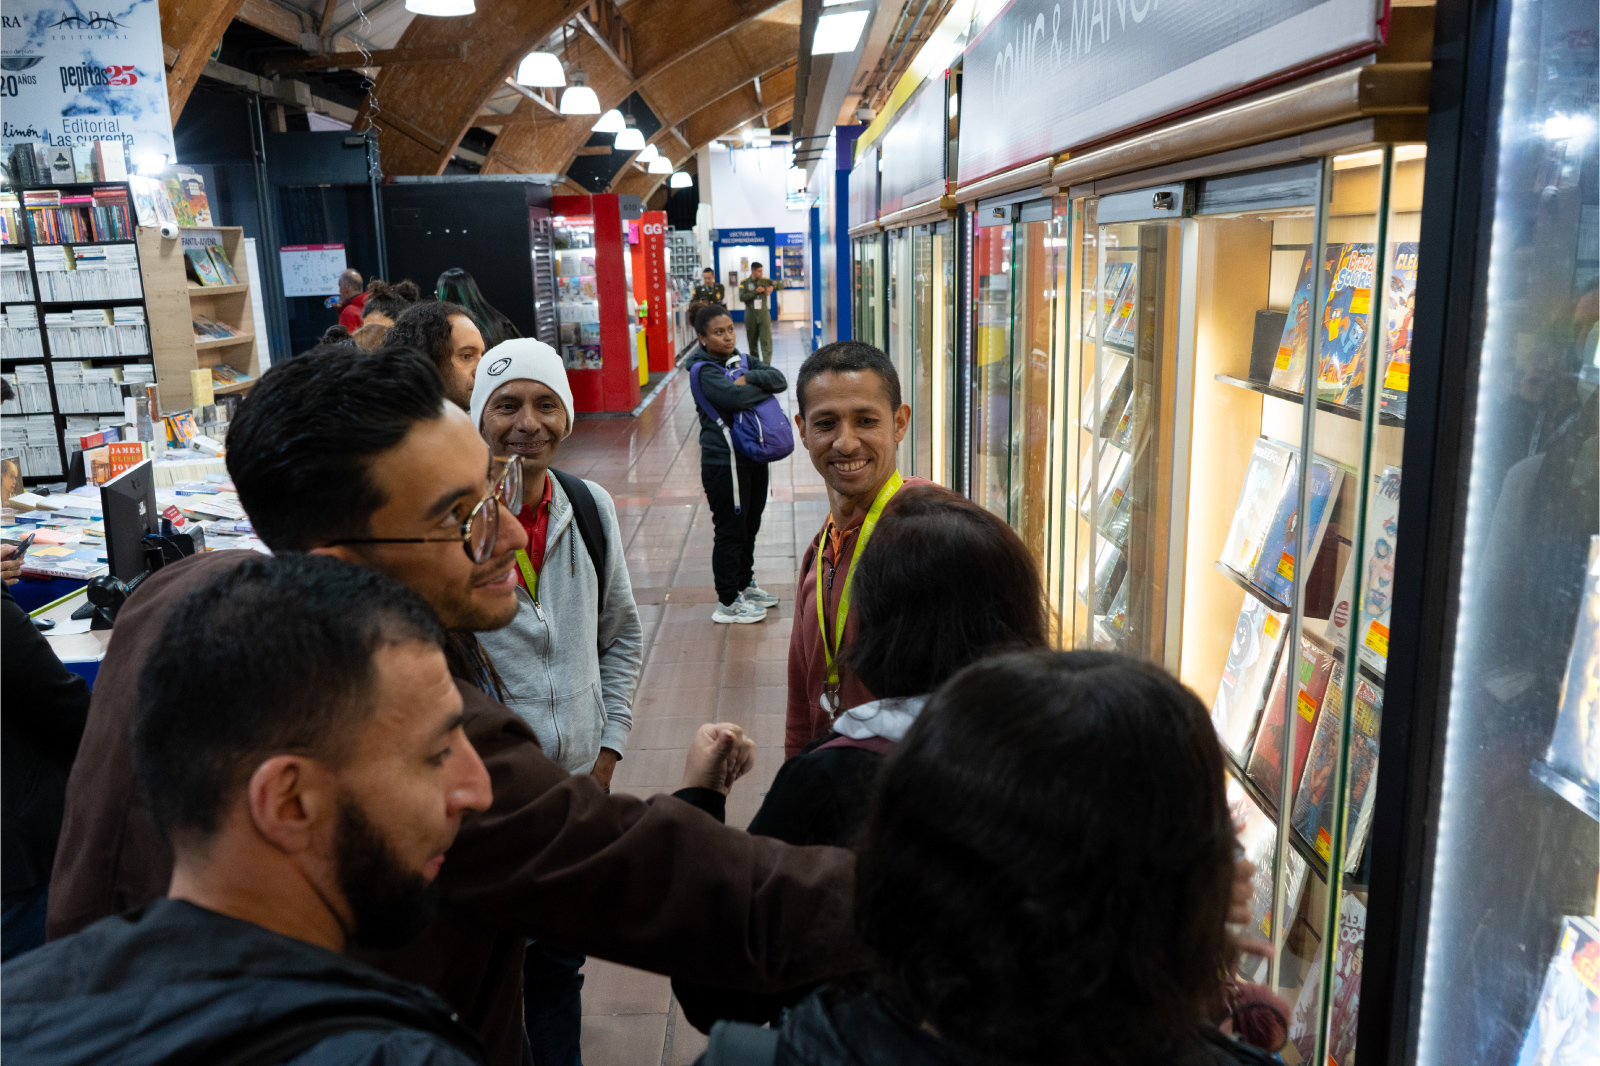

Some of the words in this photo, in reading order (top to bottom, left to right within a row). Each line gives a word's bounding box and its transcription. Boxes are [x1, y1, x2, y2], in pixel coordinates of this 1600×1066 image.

[59, 11, 119, 30] ALBA
[18, 74, 37, 85] AÑOS
[59, 62, 108, 94] pepitas
[106, 65, 138, 87] 25
[3, 121, 42, 139] limón
[62, 119, 121, 134] Editorial
[49, 132, 72, 147] Las
[643, 223, 663, 235] GG
[181, 237, 218, 246] FANTIL-JUVENIL
[111, 446, 141, 454] JAMES
